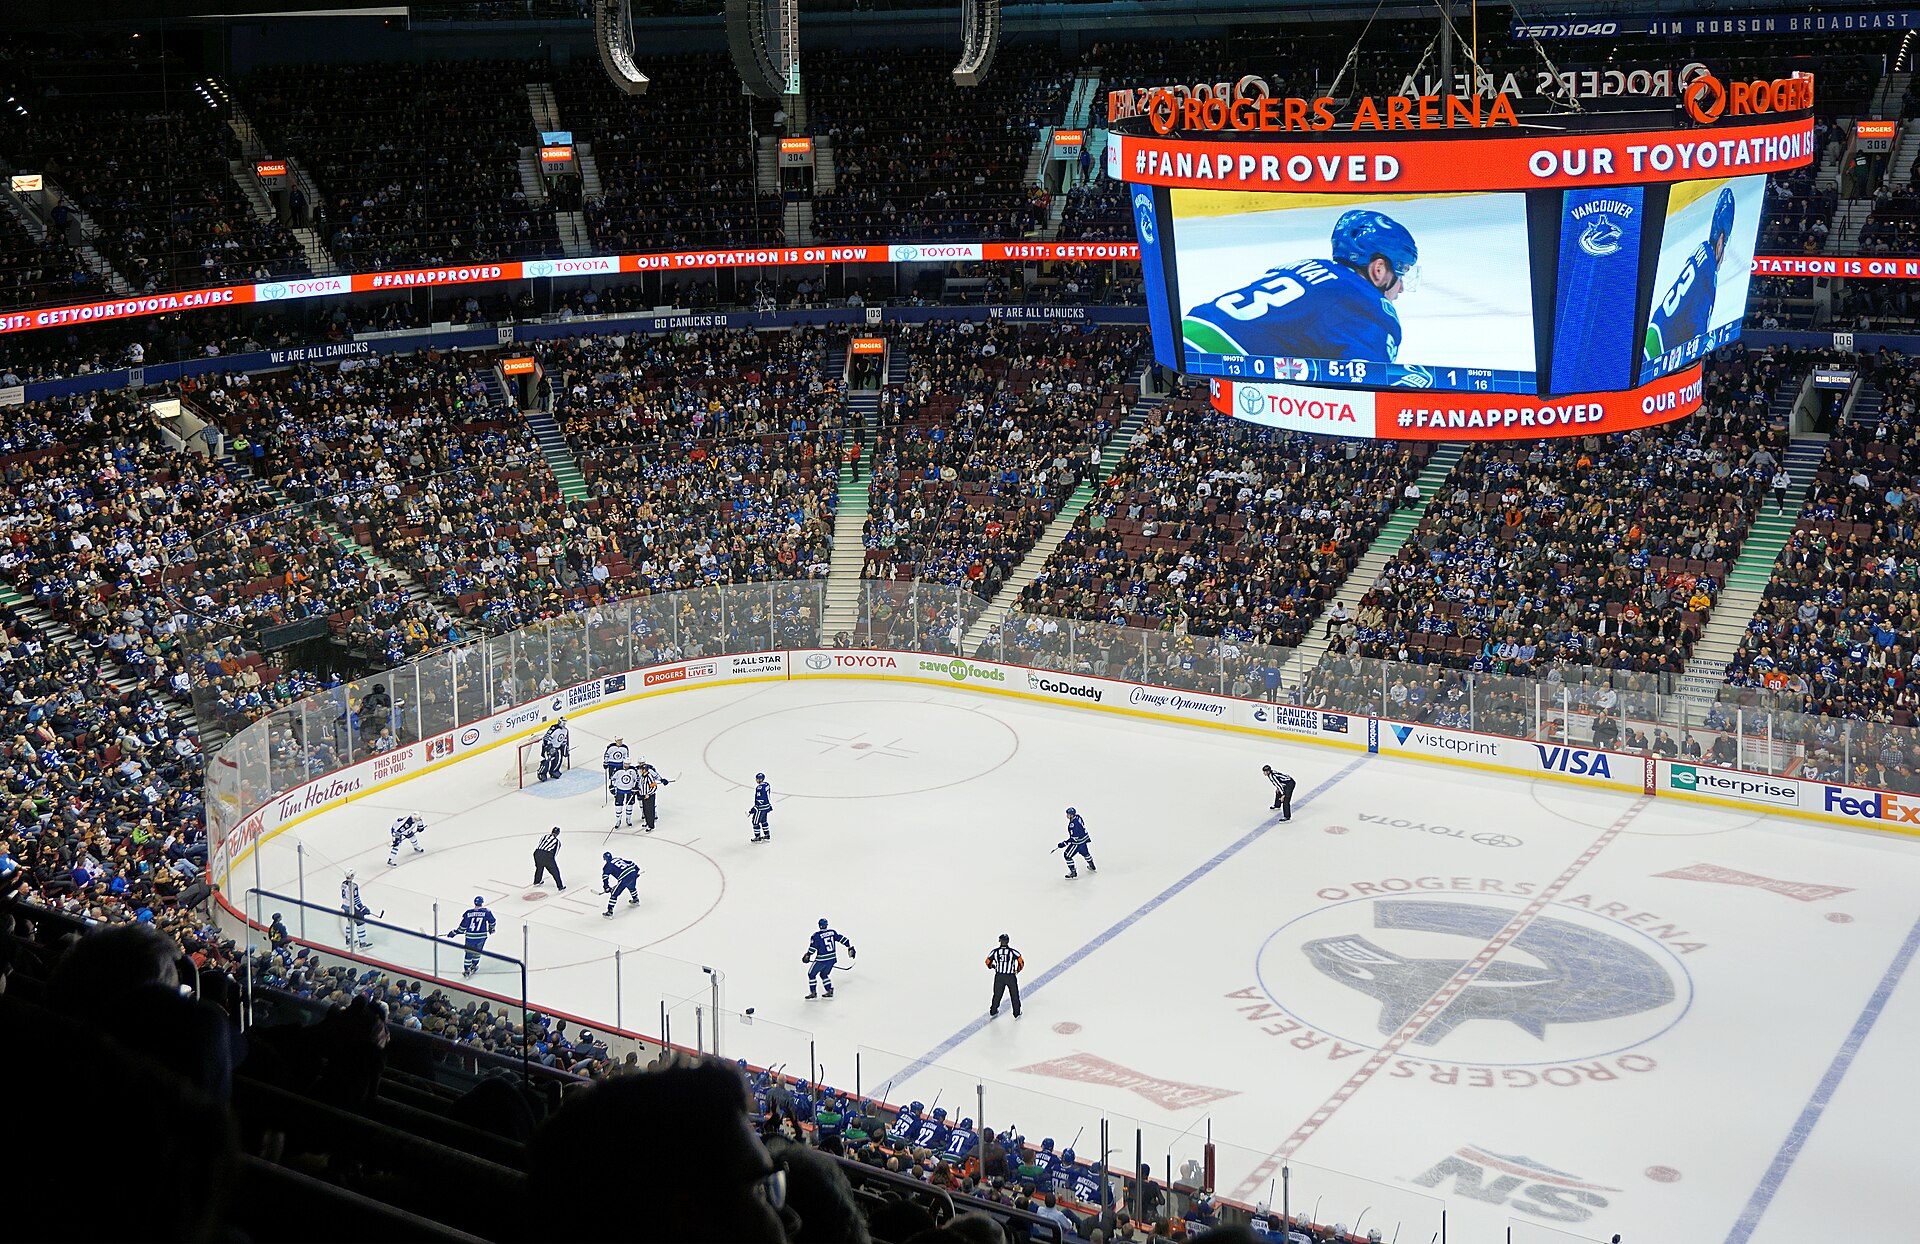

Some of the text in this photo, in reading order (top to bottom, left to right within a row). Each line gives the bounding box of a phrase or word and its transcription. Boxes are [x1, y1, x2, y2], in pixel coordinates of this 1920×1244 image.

[1567, 23, 1617, 37] 1040
[1649, 13, 1909, 34] JIM ROBSON BROADCAST
[1184, 93, 1519, 132] ROGERS ARENA
[1062, 146, 1078, 154] 305
[1867, 140, 1887, 149] 308
[788, 153, 804, 161] 304
[1135, 149, 1400, 182] #FANAPPROVED
[1529, 149, 1614, 178] OUR
[1627, 132, 1801, 172] TOYOTATHON
[548, 163, 564, 171] 303
[1570, 200, 1634, 220] VANCOUVER
[637, 248, 867, 269] OUR TOYOTATHON IS ON NOW
[920, 246, 973, 258] TOYOTA
[1004, 245, 1138, 258] VISIT: GETYOURT
[555, 260, 609, 273] TOYOTA
[1844, 261, 1862, 274] IS
[1868, 261, 1897, 275] ON
[372, 266, 501, 287] #FANAPPROVED
[288, 280, 341, 295] TOYOTA
[0, 290, 234, 330] SIT: GETYOURTOYOTA.CA/BC
[867, 308, 882, 318] 103
[990, 308, 1085, 319] WE ARE ALL CANUCKS
[654, 315, 727, 329] GO CANUCKS GO
[499, 328, 513, 338] 102
[1834, 335, 1852, 346] 106
[270, 341, 368, 363] WE ARE ALL CANUCKS
[130, 370, 144, 380] 101
[510, 362, 533, 370] ROGERS
[1228, 359, 1456, 386] 13 0 5:18 1
[1474, 379, 1487, 391] 16
[1267, 395, 1356, 423] TOYOTA
[1642, 391, 1676, 414] OUR
[1397, 403, 1603, 429] #FANAPPROVED
[834, 655, 897, 668] TOYOTA
[919, 659, 948, 673] save
[968, 664, 1005, 682] foods
[655, 670, 684, 681] ROGERS
[688, 669, 707, 677] LIVE
[568, 680, 601, 698] CANUCKS
[1039, 678, 1103, 702] GoDaddy
[1769, 680, 1781, 690] 60
[569, 689, 601, 706] REWARDS
[1170, 695, 1227, 716] Optometry
[505, 709, 540, 729] Synergy
[1276, 706, 1318, 721] CANUCKS
[1276, 715, 1318, 730] REWARDS
[1369, 719, 1377, 747] Reebok
[1415, 732, 1498, 756] vistaprint
[373, 748, 414, 771] THIS BUD'S
[1532, 743, 1612, 779] VISA
[374, 761, 407, 781] FOR YOU.
[1646, 758, 1654, 789] Reebok
[1672, 770, 1796, 800] enterprise
[278, 777, 361, 822] Tim Hortons
[1824, 785, 1920, 825] FedEx
[1358, 813, 1465, 839] TOYOTA
[469, 917, 484, 932] 47
[1351, 876, 1708, 955] ROGERS ARENA
[823, 936, 835, 952] 51
[1224, 985, 1621, 1089] ARENA ROGERS
[891, 1119, 910, 1136] 33
[915, 1127, 935, 1146] 22
[947, 1135, 965, 1153] 21
[1074, 1183, 1092, 1203] 25
